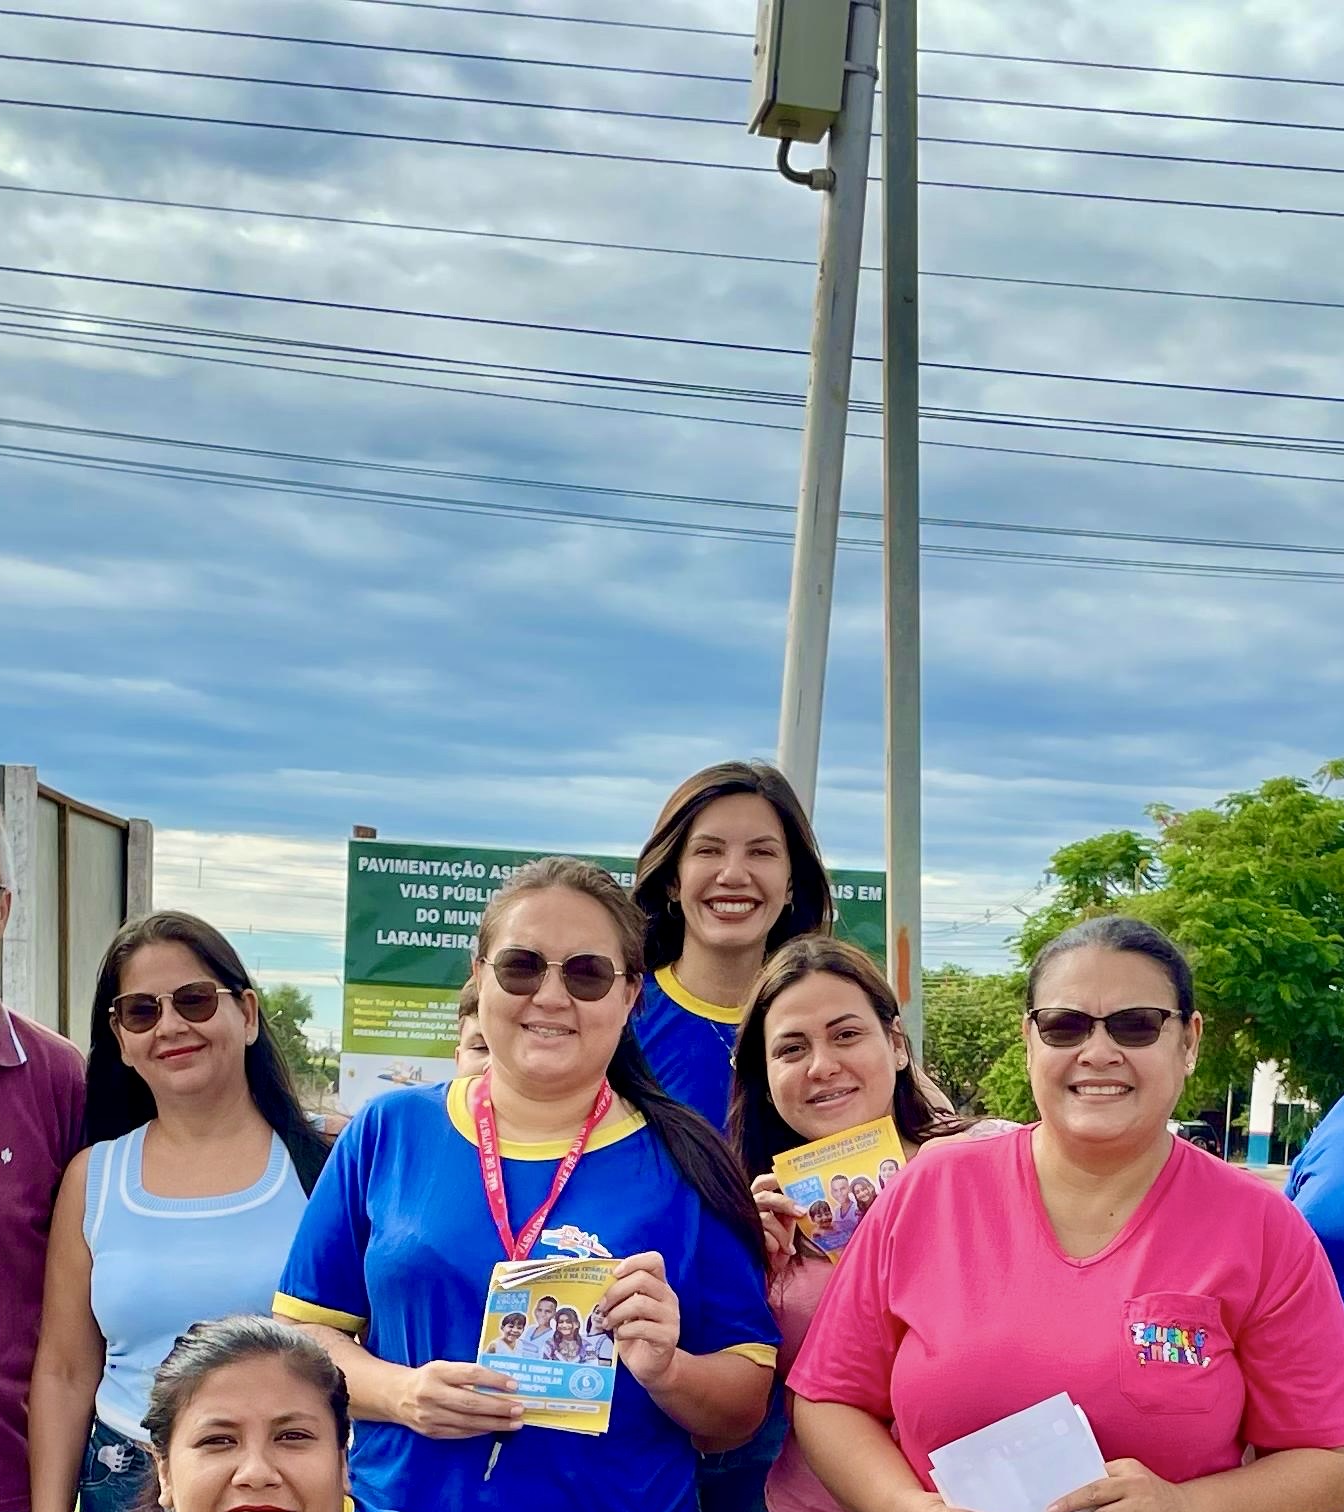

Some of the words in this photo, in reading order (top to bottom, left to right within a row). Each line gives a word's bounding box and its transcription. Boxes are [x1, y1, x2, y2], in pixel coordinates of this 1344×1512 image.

[358, 856, 486, 881] PAVIMENTAÇÃO
[400, 883, 439, 900] VIAS
[443, 884, 502, 903] PÚBLIC
[857, 886, 883, 901] EM
[416, 908, 440, 924] DO
[376, 930, 480, 950] LARANJEIRA
[392, 1010, 419, 1019] PORTO
[479, 1117, 497, 1155] AUTISTA
[484, 1156, 496, 1170] DE
[564, 1153, 579, 1169] DE
